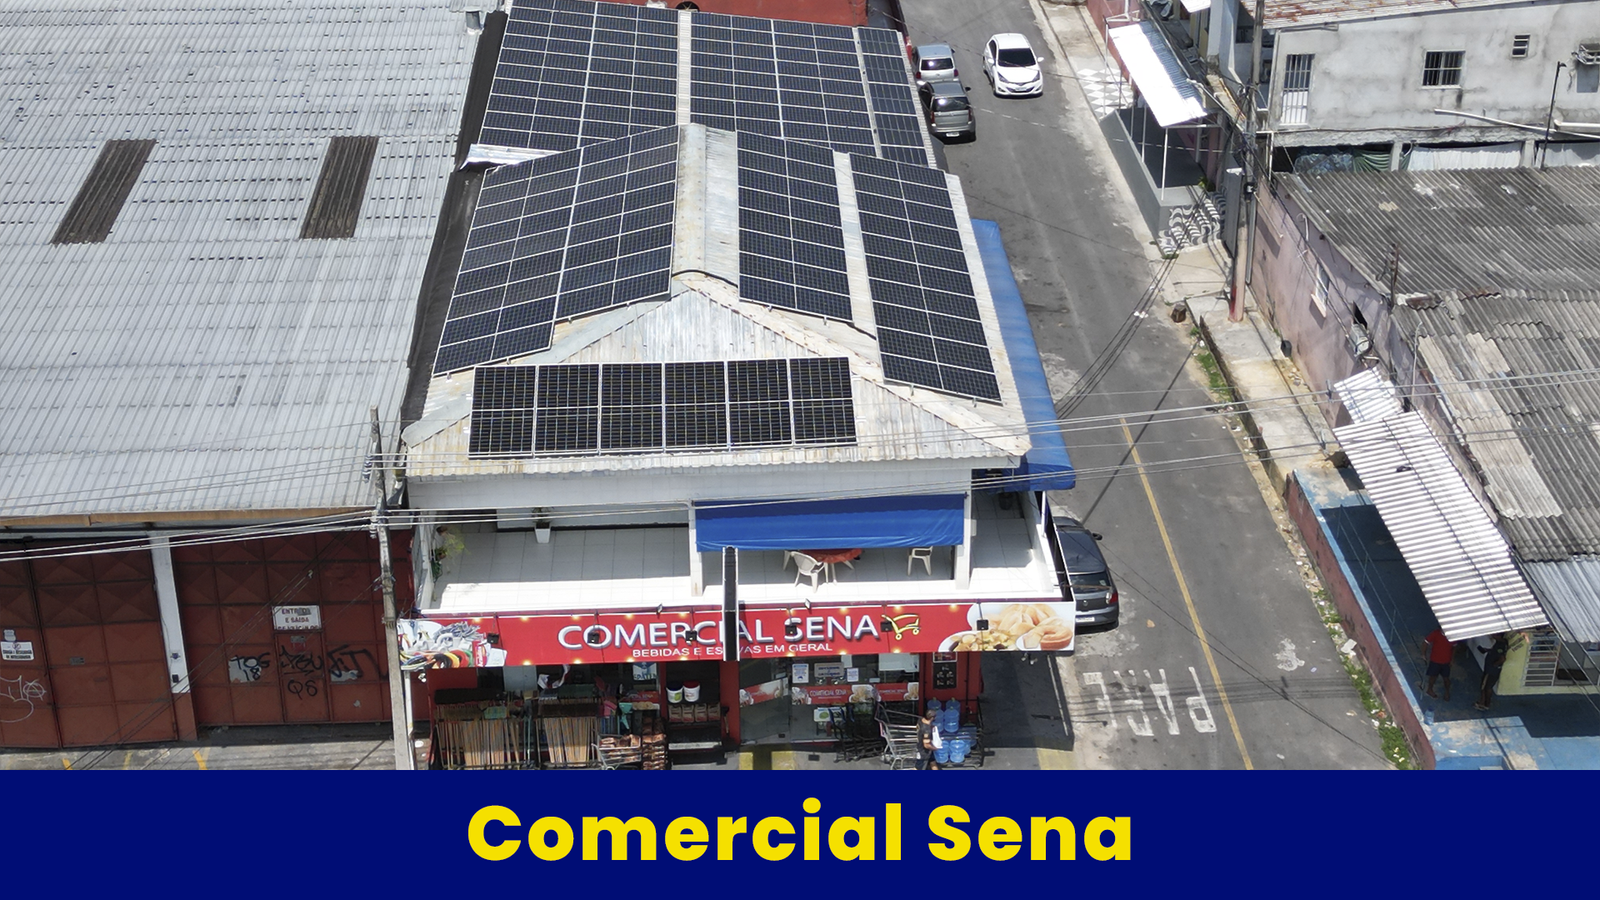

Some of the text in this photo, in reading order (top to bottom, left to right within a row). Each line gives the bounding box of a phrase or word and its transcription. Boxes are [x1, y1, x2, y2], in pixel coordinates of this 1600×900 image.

[557, 615, 880, 649] COMERCIAL SENA
[632, 643, 833, 658] BEBIDAS E ESVAS EM GERAL
[1083, 666, 1217, 736] PARE
